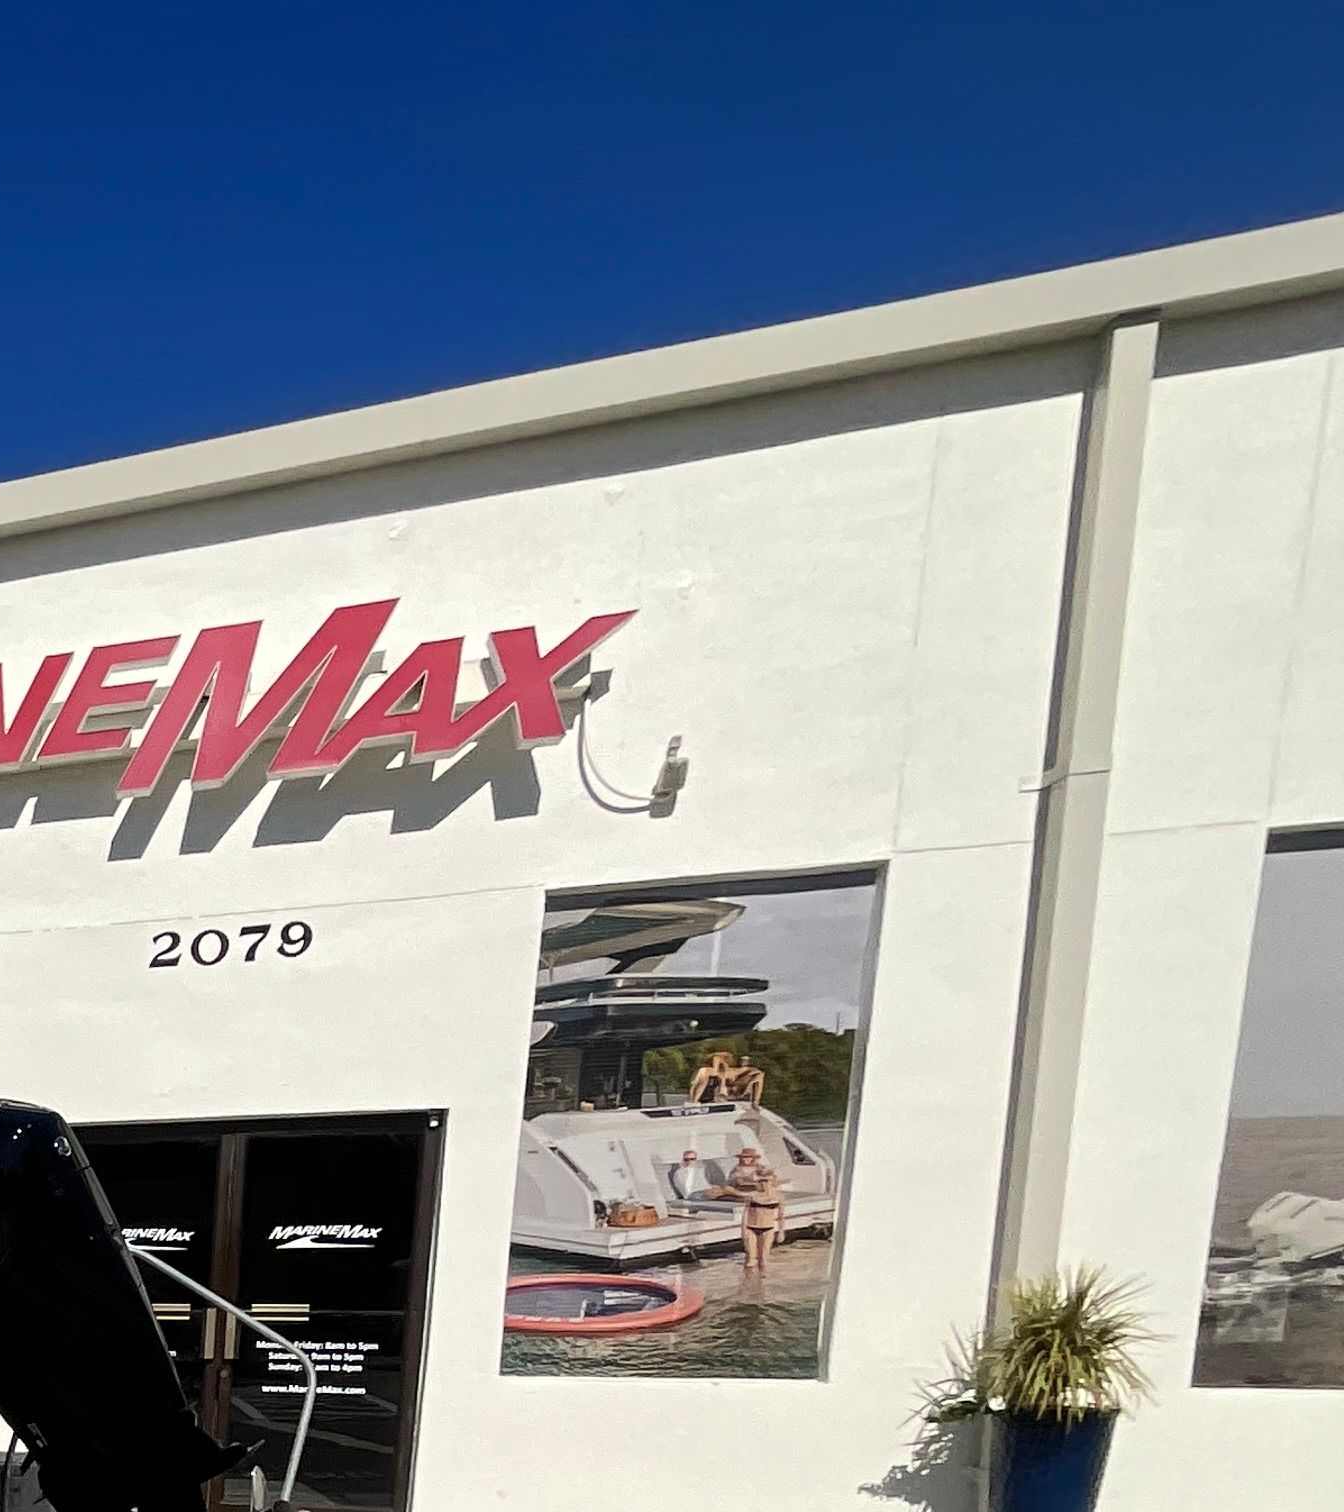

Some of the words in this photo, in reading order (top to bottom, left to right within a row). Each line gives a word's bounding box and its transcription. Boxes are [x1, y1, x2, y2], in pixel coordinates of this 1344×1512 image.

[149, 921, 313, 968] 2079
[121, 1227, 196, 1242] RINEMAX
[346, 1342, 357, 1350] to
[332, 1353, 343, 1361] to
[330, 1364, 341, 1372] to
[261, 1384, 366, 1395] www.MareMax.com
